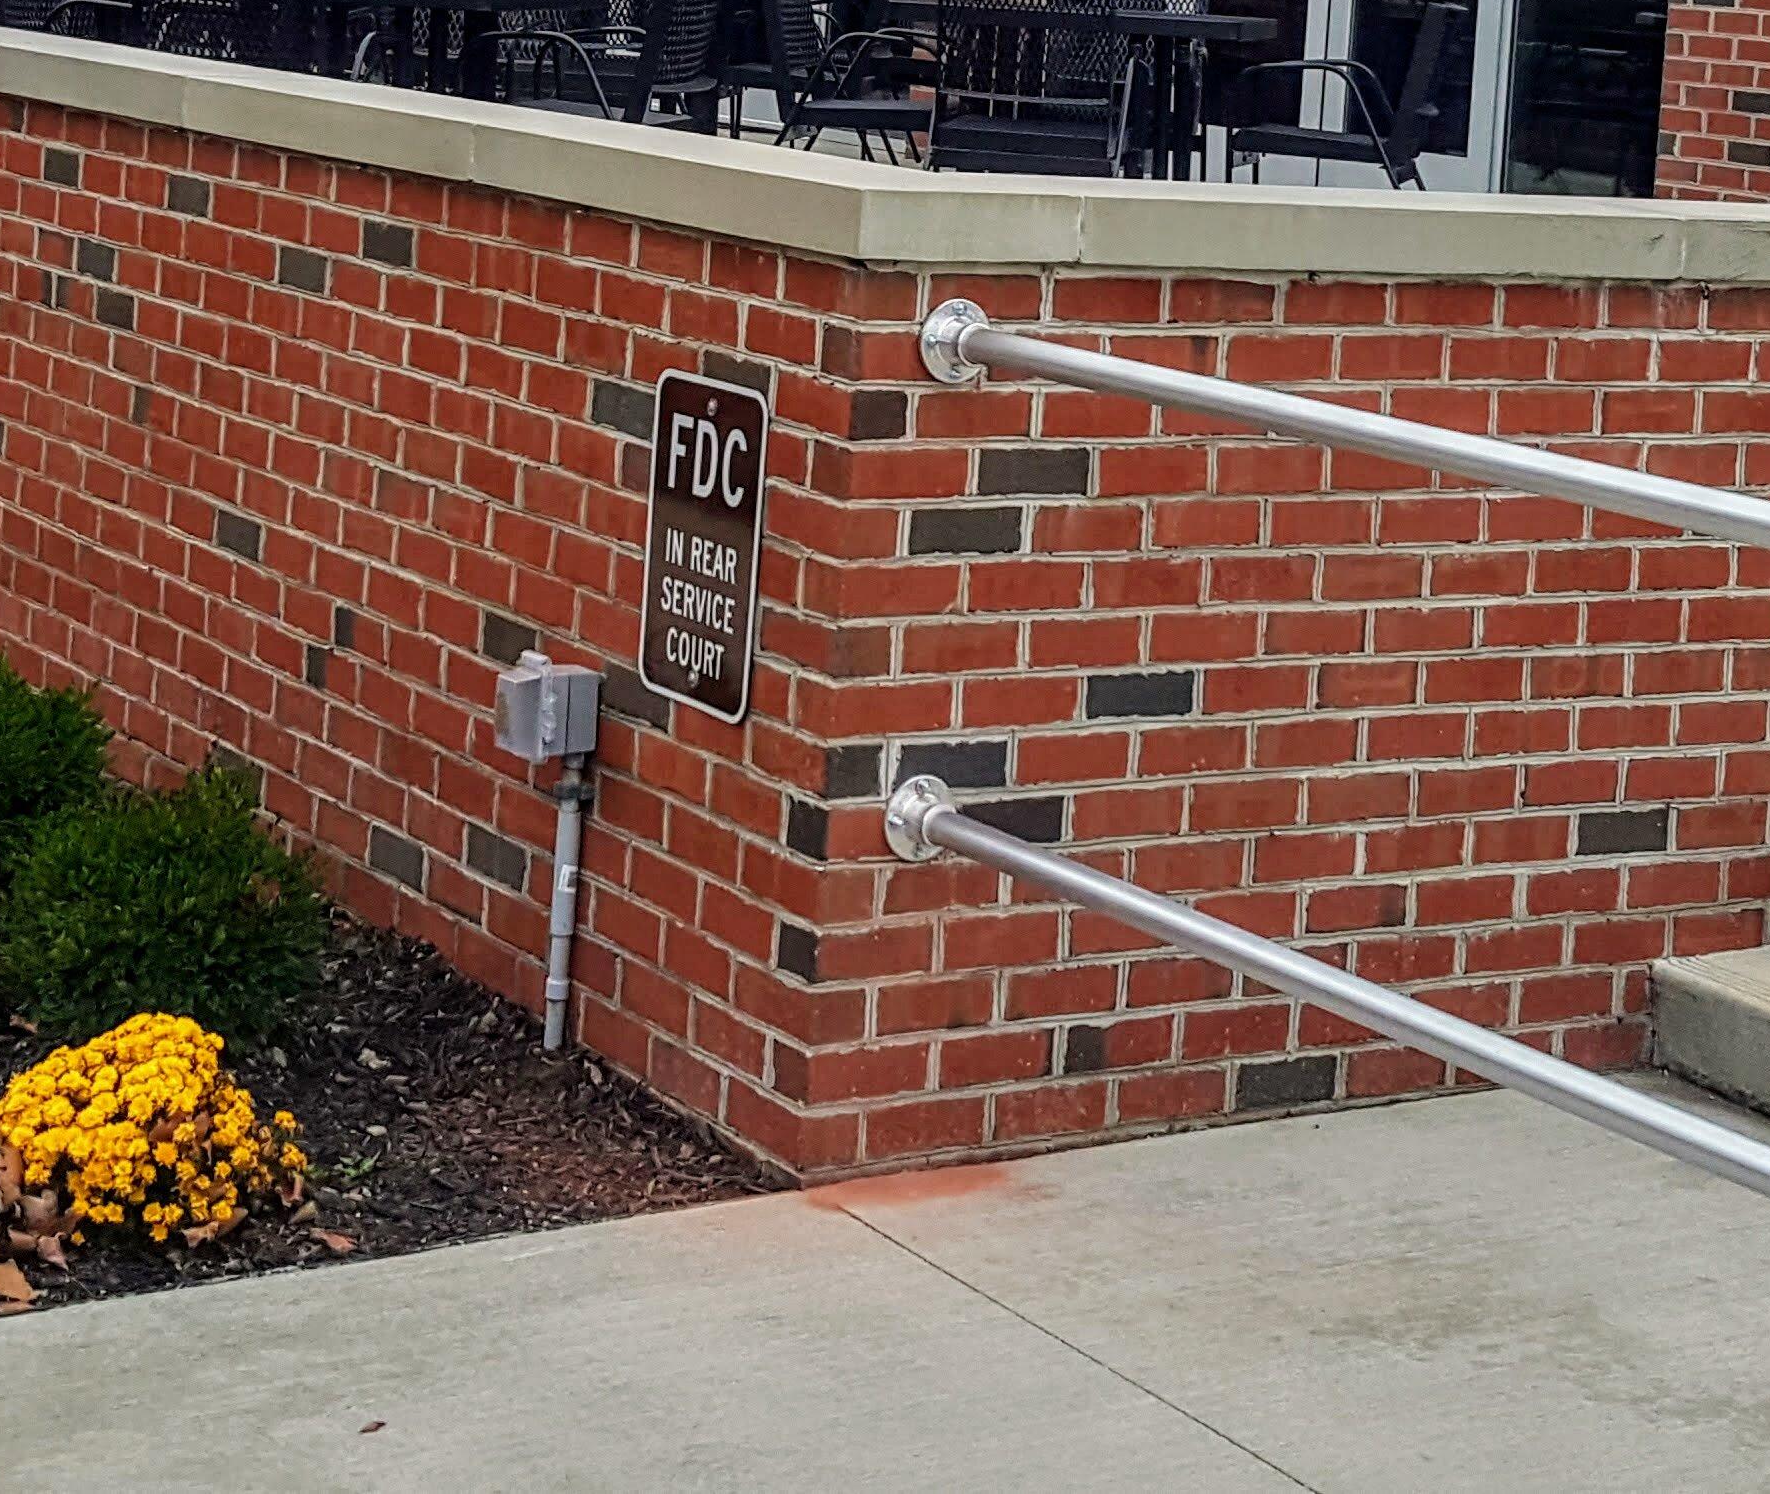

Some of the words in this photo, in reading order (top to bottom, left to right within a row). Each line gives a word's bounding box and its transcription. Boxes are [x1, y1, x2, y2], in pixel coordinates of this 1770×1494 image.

[666, 411, 749, 508] FDC
[664, 526, 685, 568] IN
[689, 536, 739, 585] REAR
[660, 576, 736, 636] SERVICE
[665, 626, 725, 682] COURT
